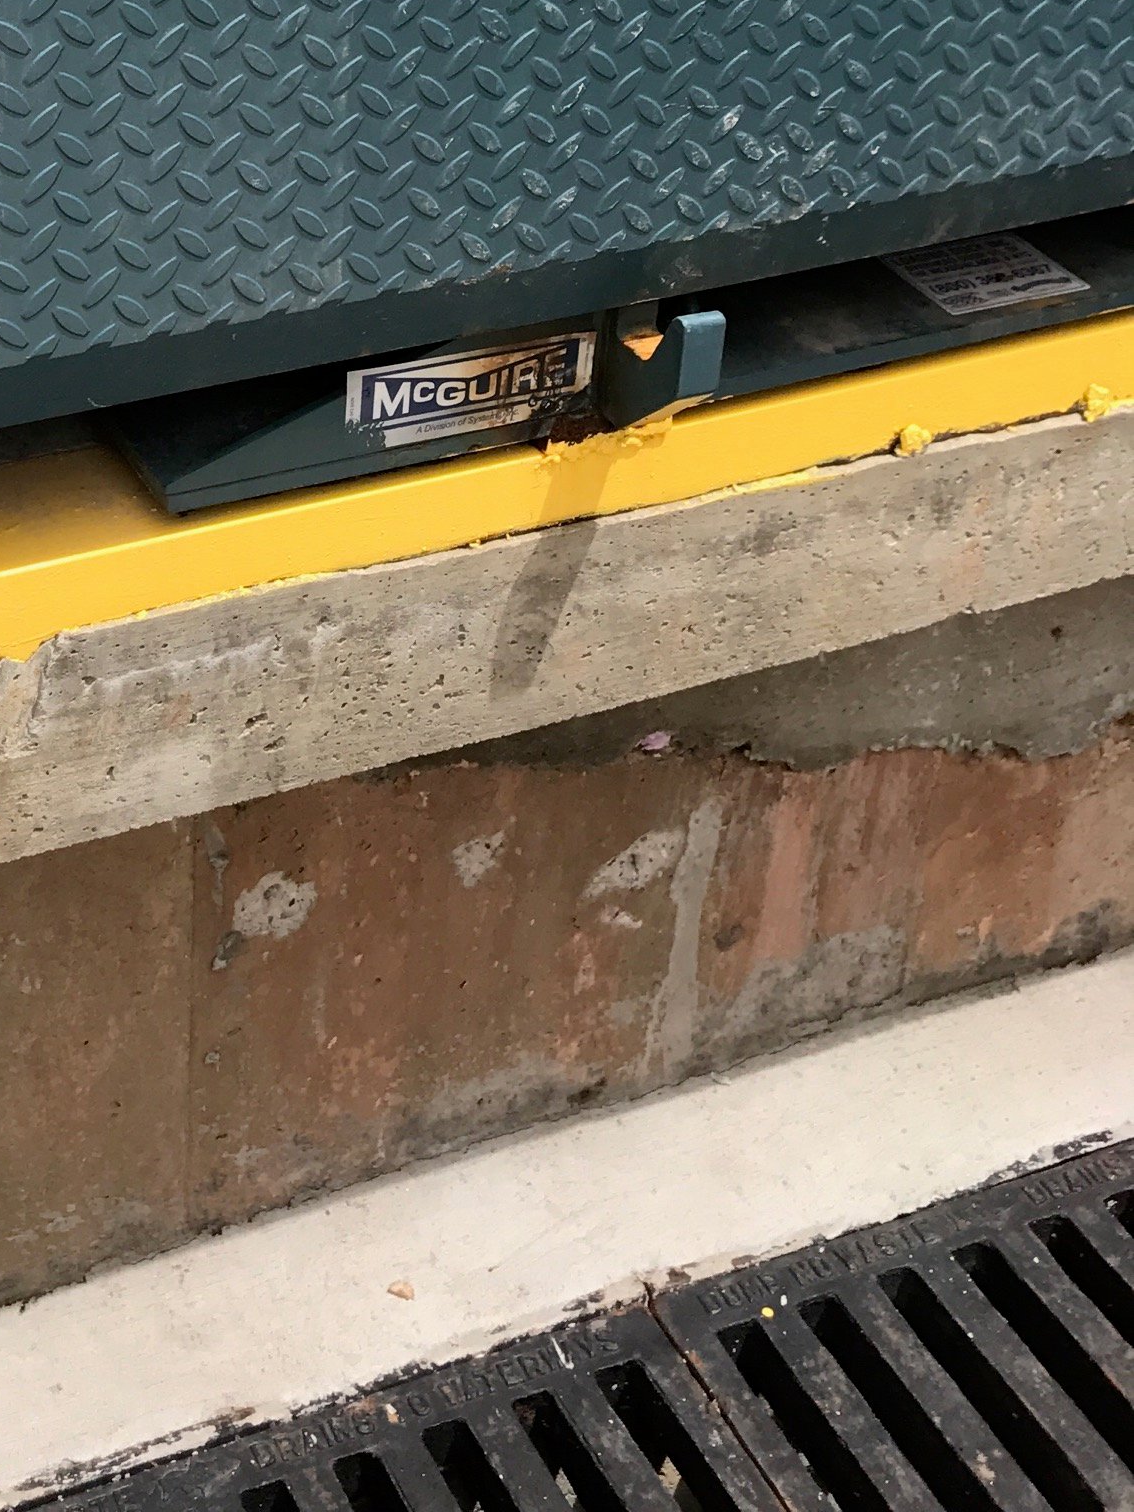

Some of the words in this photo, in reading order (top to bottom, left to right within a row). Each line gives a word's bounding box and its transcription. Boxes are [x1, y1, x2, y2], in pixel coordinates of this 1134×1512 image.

[415, 426, 424, 435] A
[425, 421, 457, 434] Division
[458, 416, 468, 427] of
